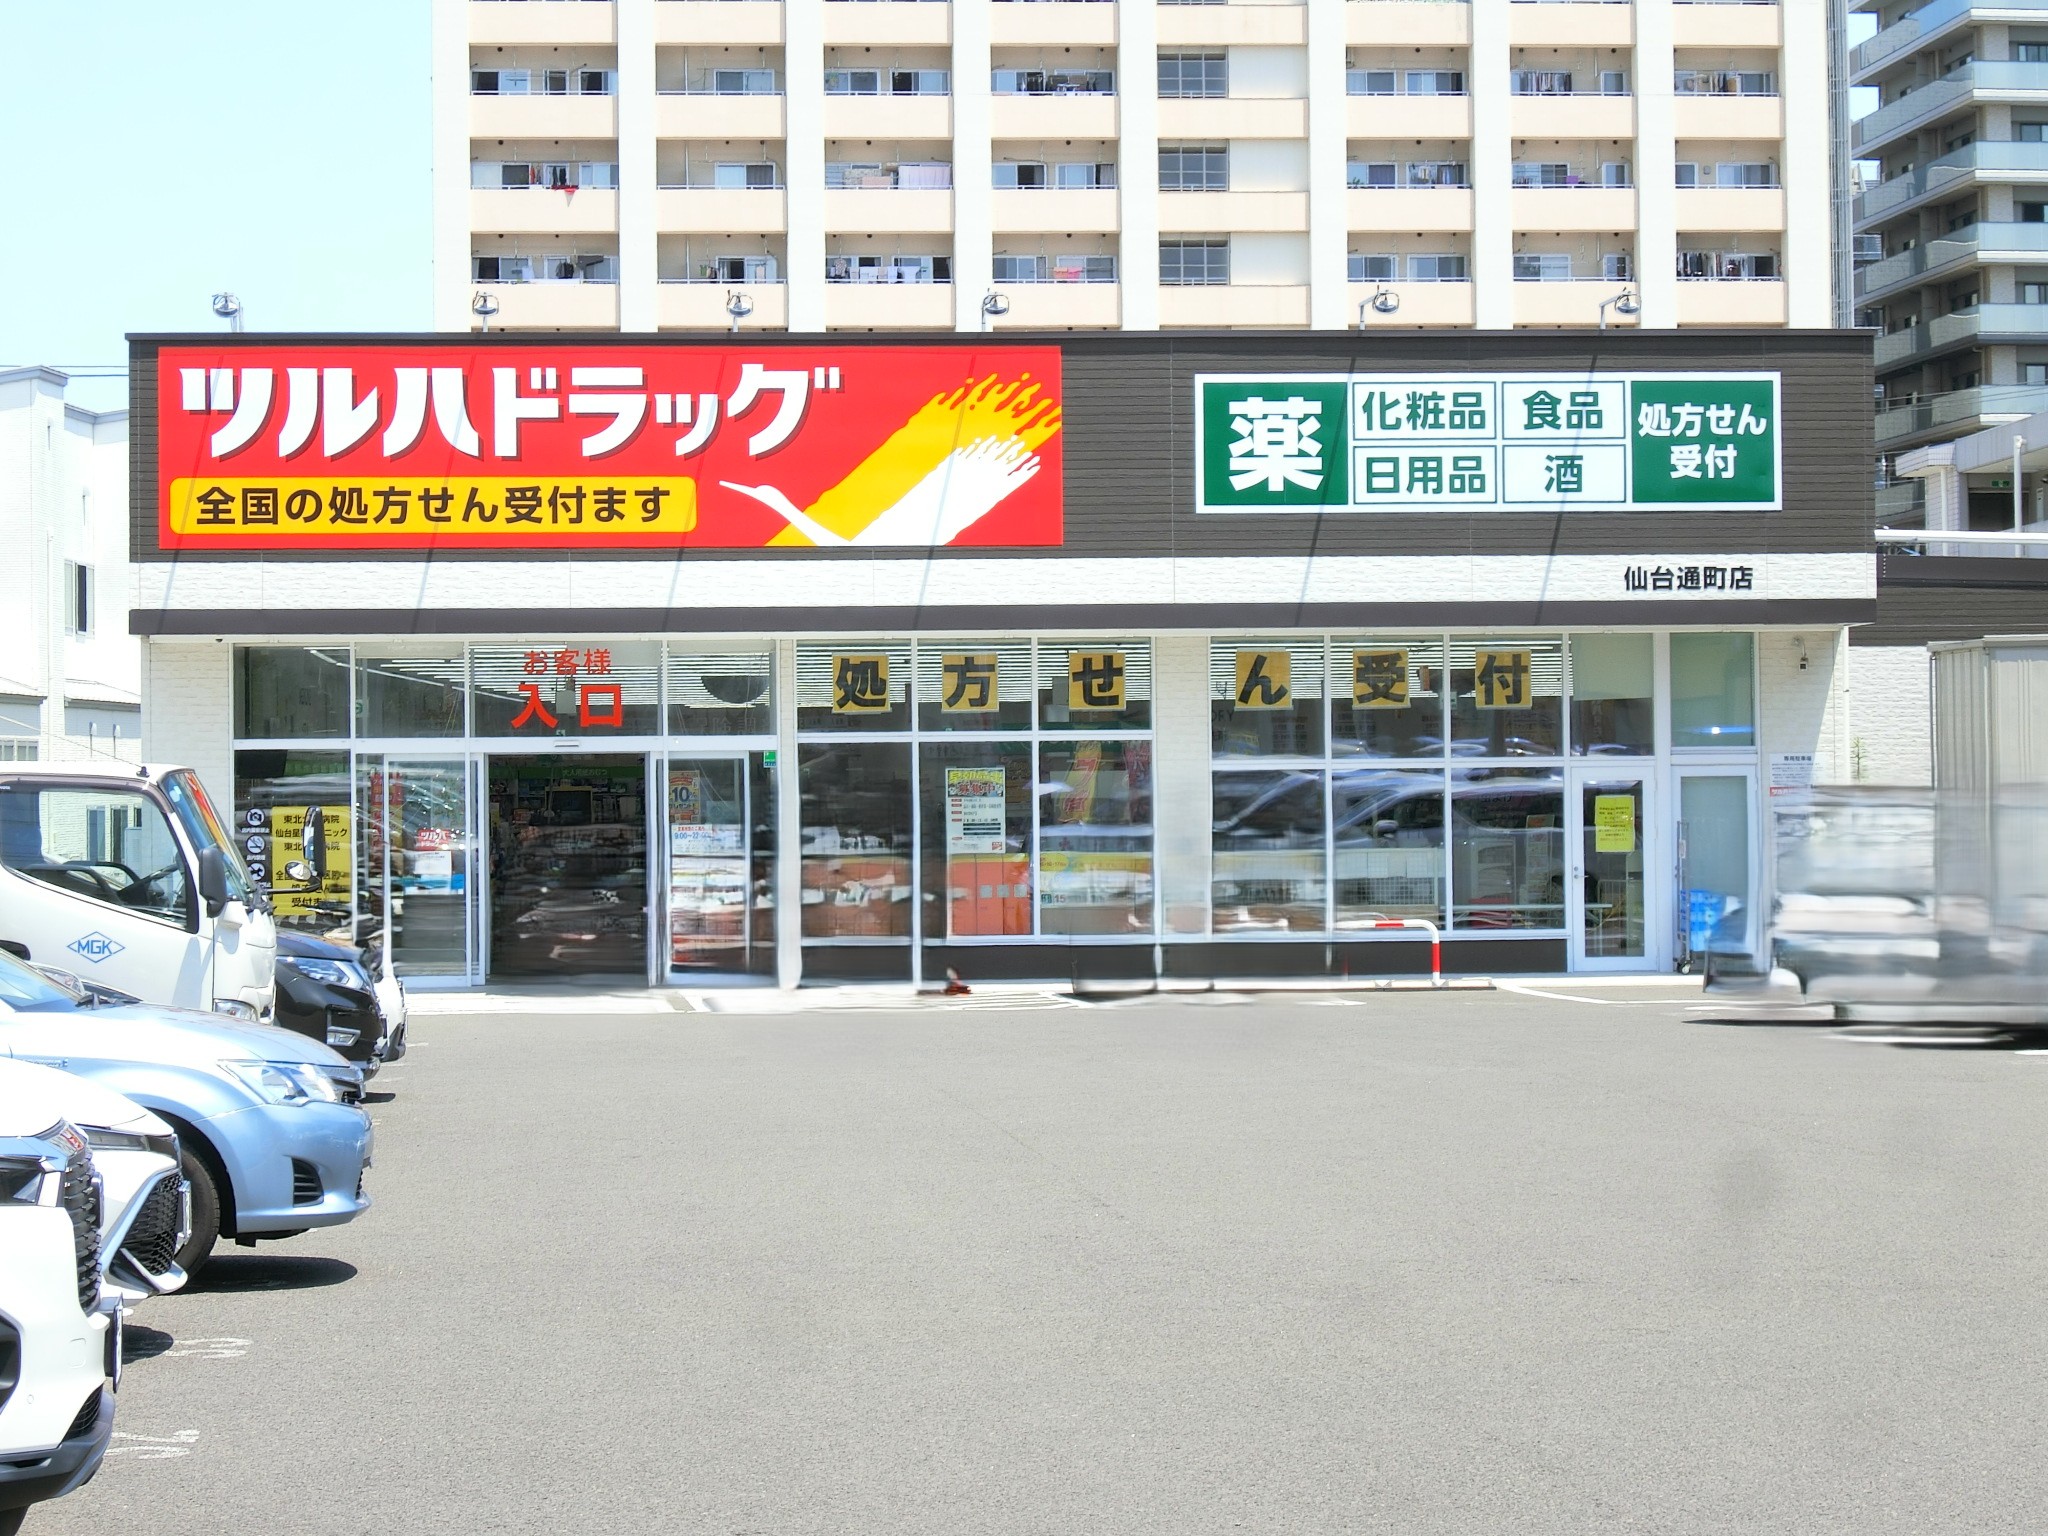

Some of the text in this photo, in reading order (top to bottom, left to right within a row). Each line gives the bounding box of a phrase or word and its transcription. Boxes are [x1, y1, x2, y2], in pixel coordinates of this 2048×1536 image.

[179, 363, 843, 460] ツルハドラッグ
[1362, 391, 1486, 430] 化粧品
[1523, 390, 1603, 430] 食品
[1637, 403, 1767, 437] 処方せん
[1228, 396, 1324, 491] 薬
[1669, 443, 1738, 479] 受付
[1366, 456, 1486, 494] 日用品
[1545, 455, 1583, 493] 酒
[196, 485, 670, 525] 全国の処方せん受付ます
[1623, 566, 1753, 591] 仙台通町店
[524, 648, 611, 675] お客様
[511, 682, 623, 729] 入口
[77, 939, 113, 955] MGK
